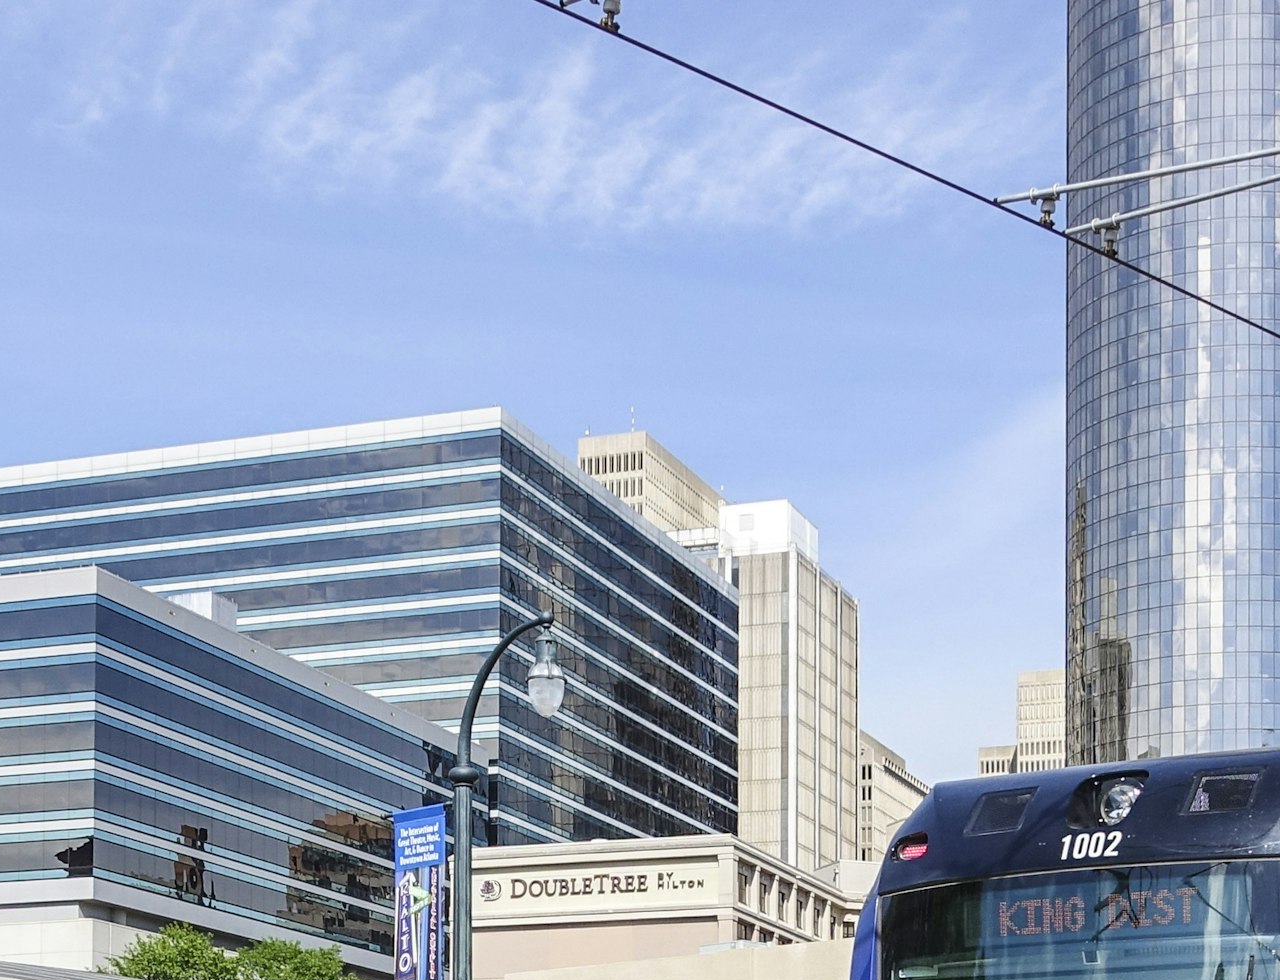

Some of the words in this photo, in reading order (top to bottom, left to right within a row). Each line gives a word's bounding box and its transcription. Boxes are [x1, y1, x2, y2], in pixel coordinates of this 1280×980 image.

[1060, 831, 1122, 860] 1002
[400, 855, 423, 866] Downtown
[423, 852, 439, 862] Atlanta
[657, 872, 674, 882] BY
[657, 879, 705, 890] HILTON
[999, 896, 1085, 936] KING
[1107, 887, 1199, 929] DIST
[399, 882, 412, 973] RIALTO
